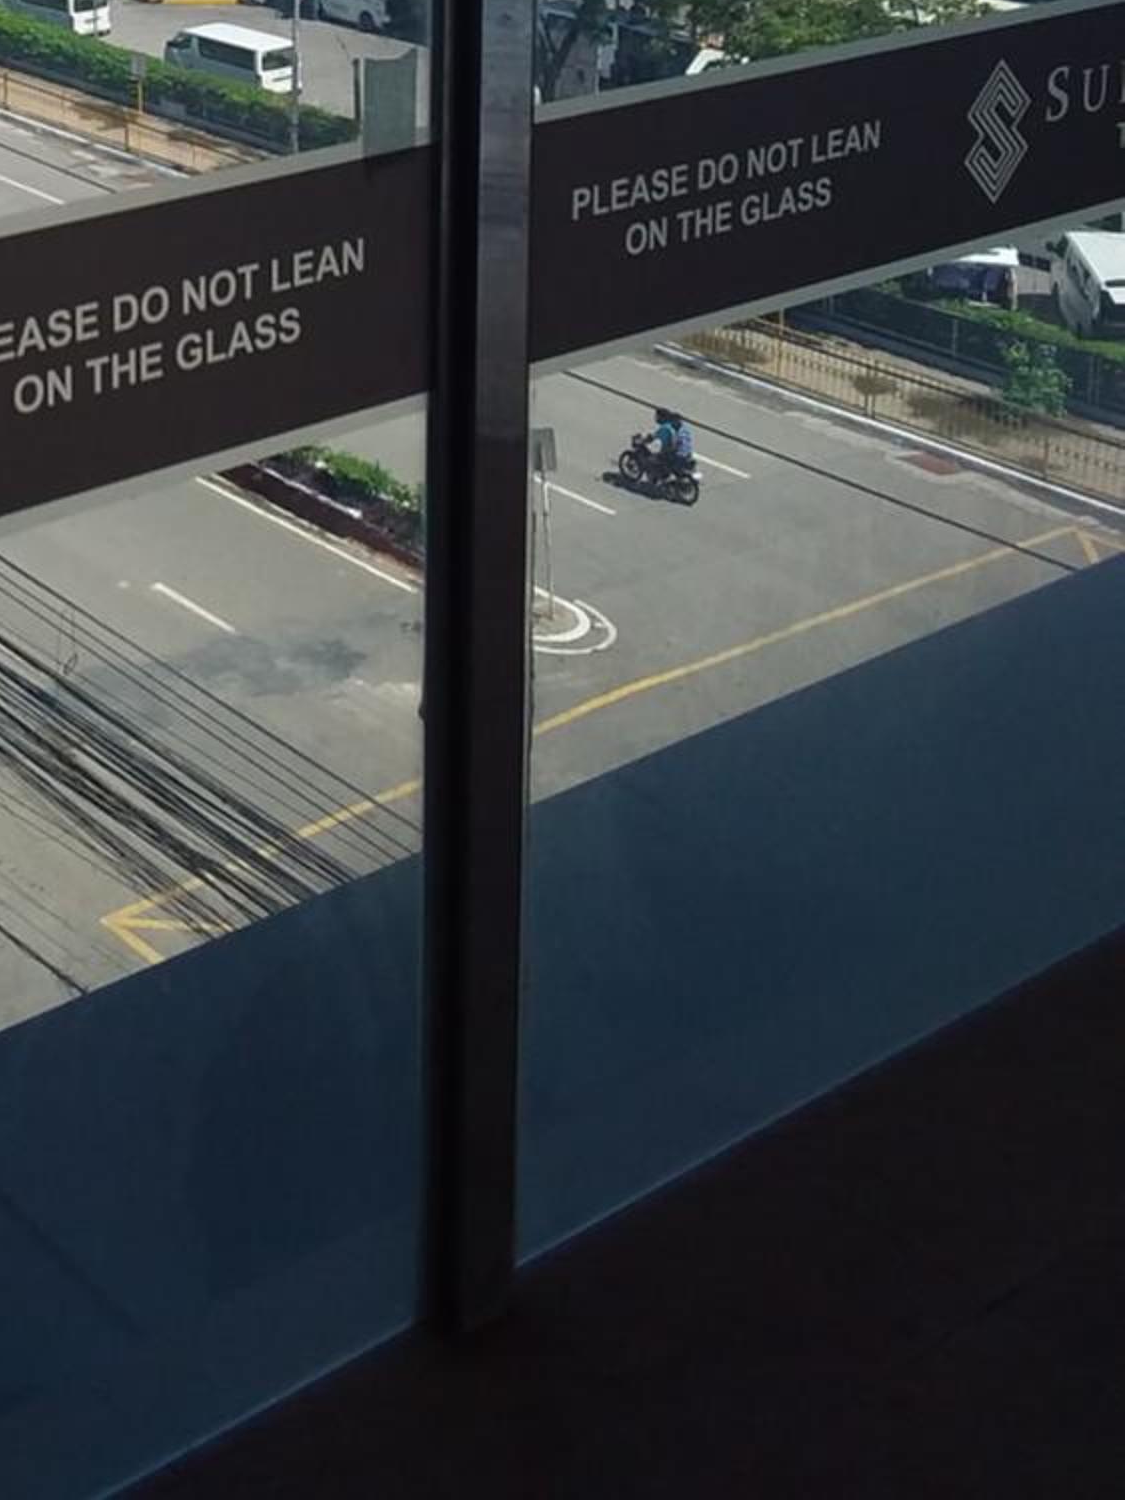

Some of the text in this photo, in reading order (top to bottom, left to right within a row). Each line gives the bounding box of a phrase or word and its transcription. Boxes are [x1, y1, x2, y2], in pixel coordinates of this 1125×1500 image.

[1046, 62, 1125, 122] SU
[572, 120, 882, 221] PLEASE DO NOT LEAN
[625, 177, 833, 256] ON THE GLASS
[113, 286, 171, 333] DO
[182, 263, 259, 315] NOT
[270, 237, 365, 293] LEAN
[13, 307, 301, 414] ON THE GLASS
